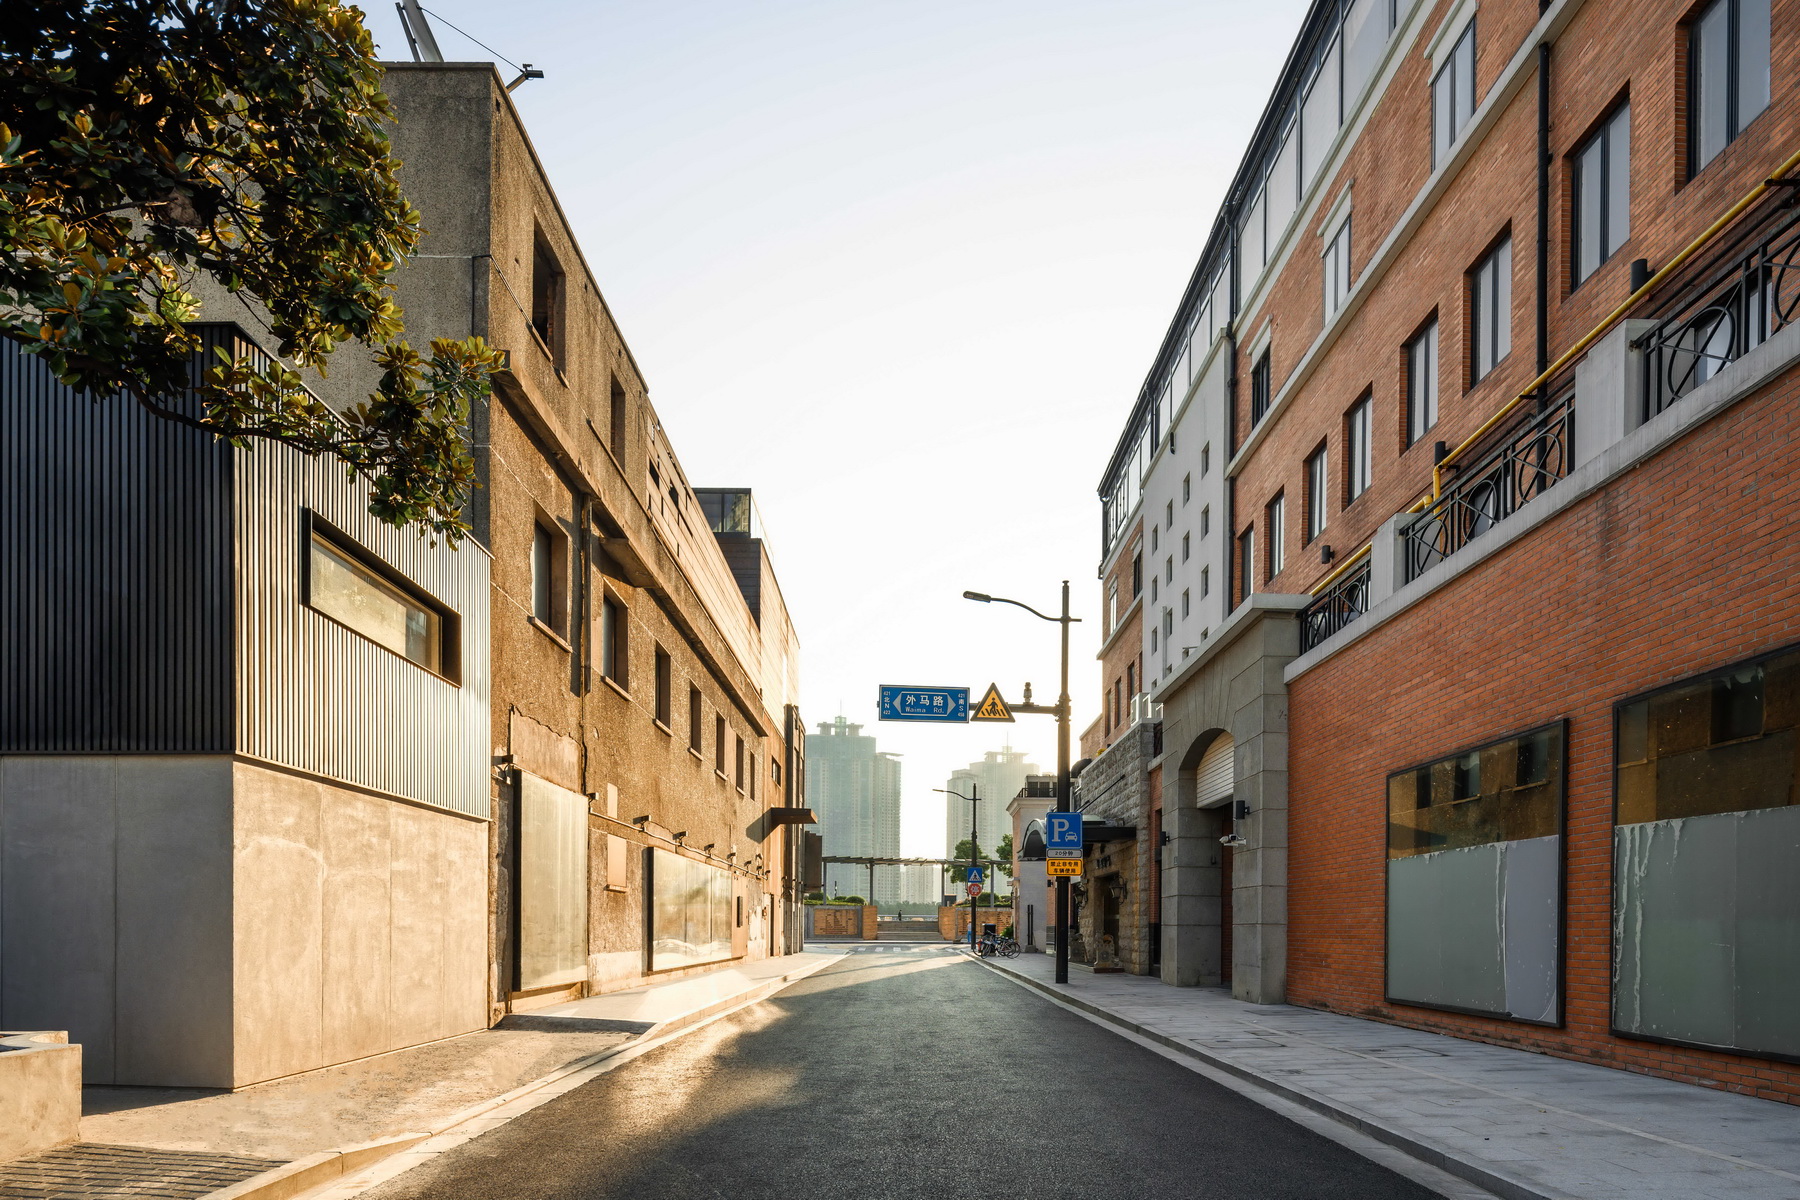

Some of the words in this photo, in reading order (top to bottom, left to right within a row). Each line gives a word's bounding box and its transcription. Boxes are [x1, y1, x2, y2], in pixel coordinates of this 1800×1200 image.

[906, 695, 944, 706] 外马路
[1052, 818, 1070, 842] P
